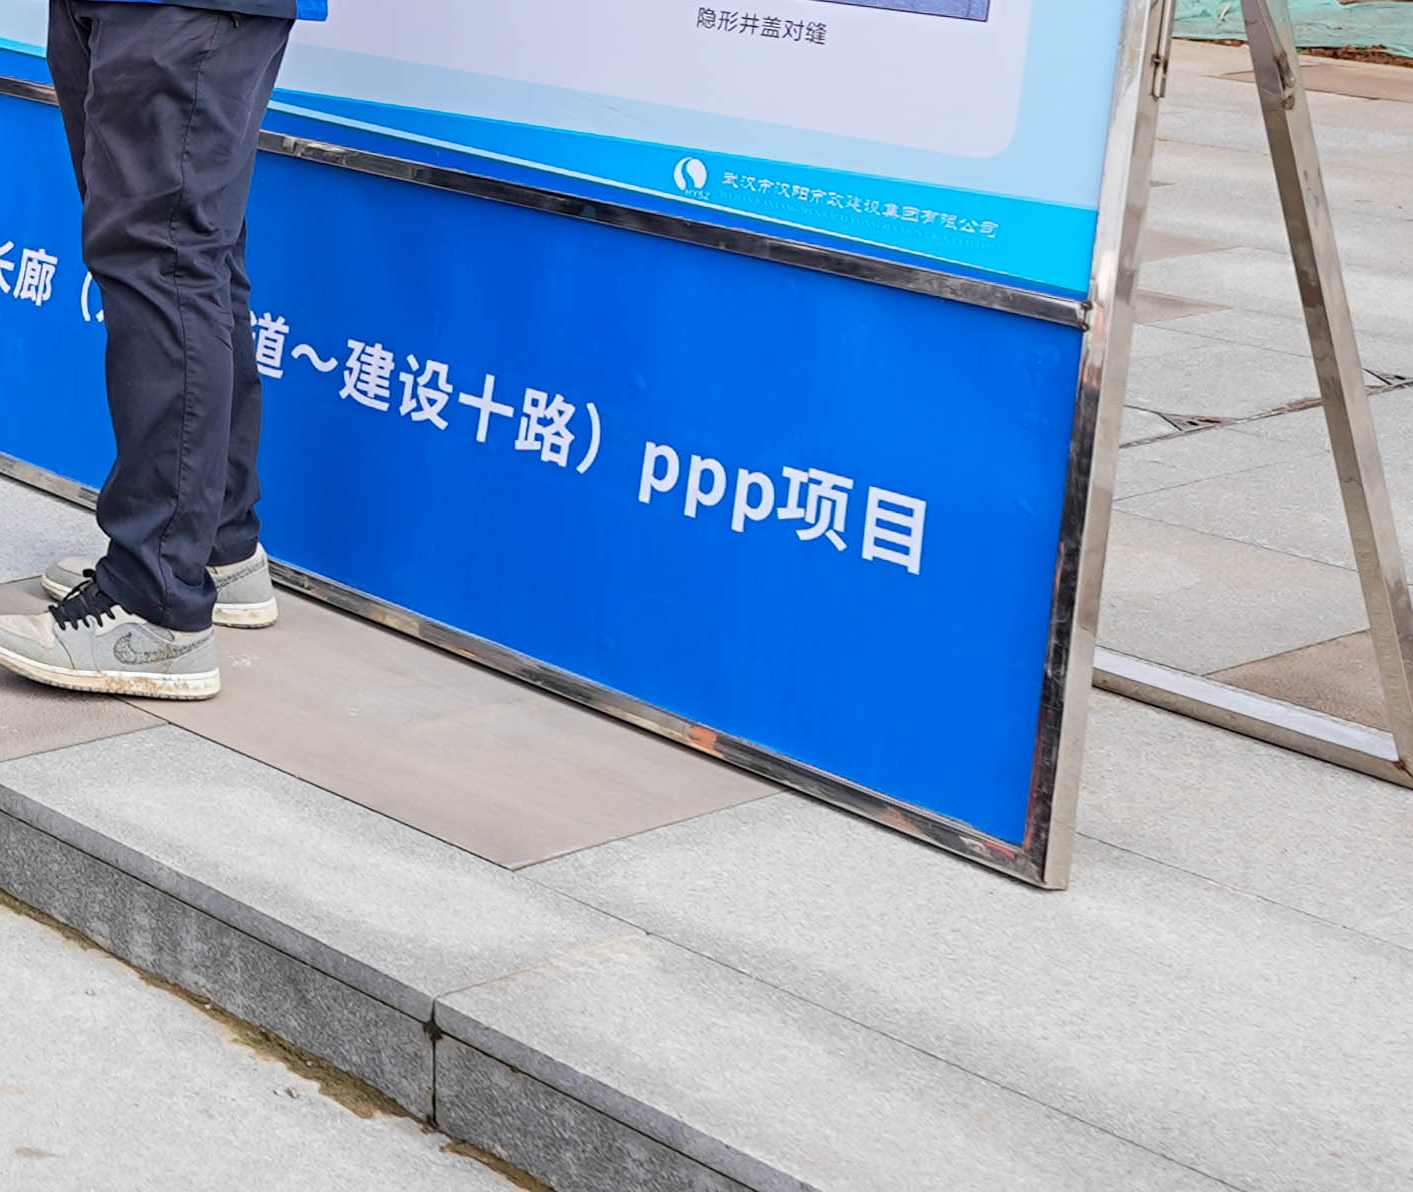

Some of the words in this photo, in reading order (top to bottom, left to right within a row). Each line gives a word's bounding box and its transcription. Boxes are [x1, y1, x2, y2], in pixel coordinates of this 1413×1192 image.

[695, 6, 828, 46] 隐形井盖对缝
[722, 170, 1000, 238] 武汉市汉阳市政建设集团有限公司
